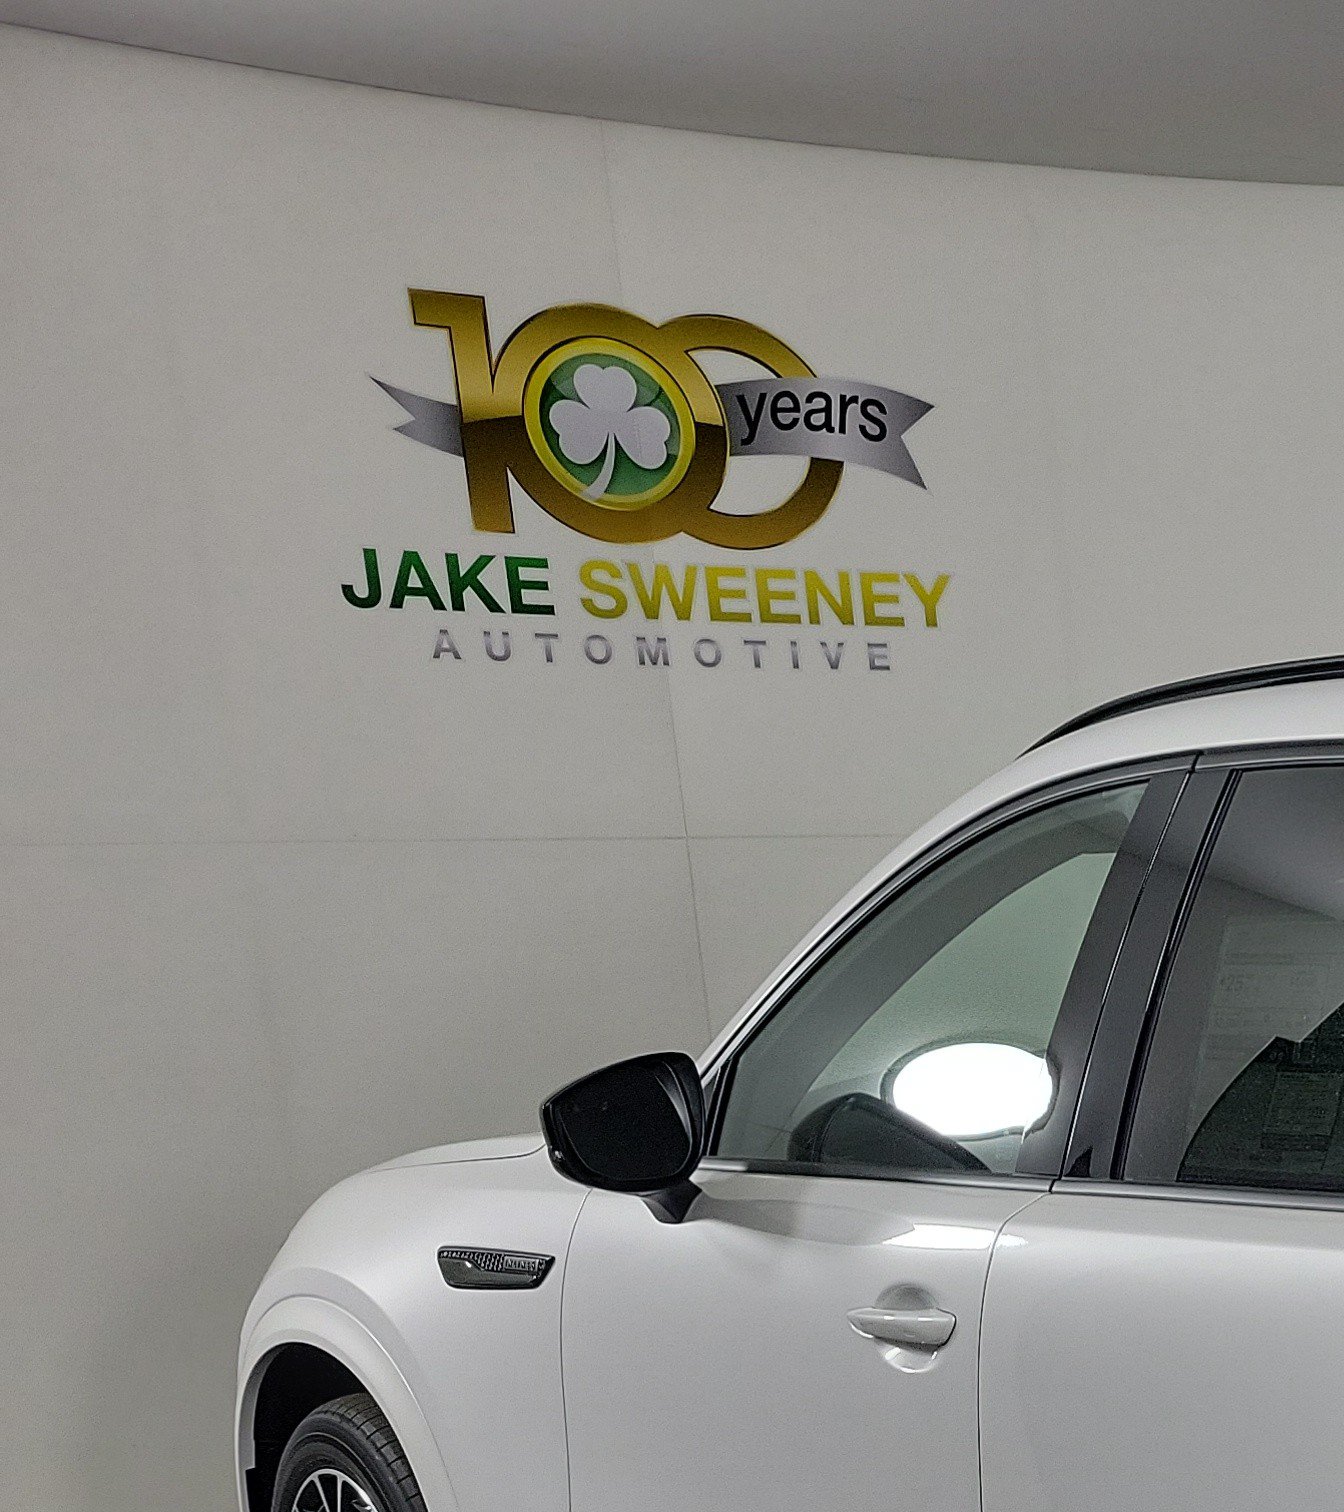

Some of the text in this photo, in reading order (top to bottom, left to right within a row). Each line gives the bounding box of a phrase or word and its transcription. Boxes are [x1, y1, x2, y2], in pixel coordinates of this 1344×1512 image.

[407, 287, 845, 551] 100
[735, 387, 890, 446] years
[341, 547, 953, 628] JAKE SWEENEY
[432, 628, 892, 671] AUTOMOTIVE
